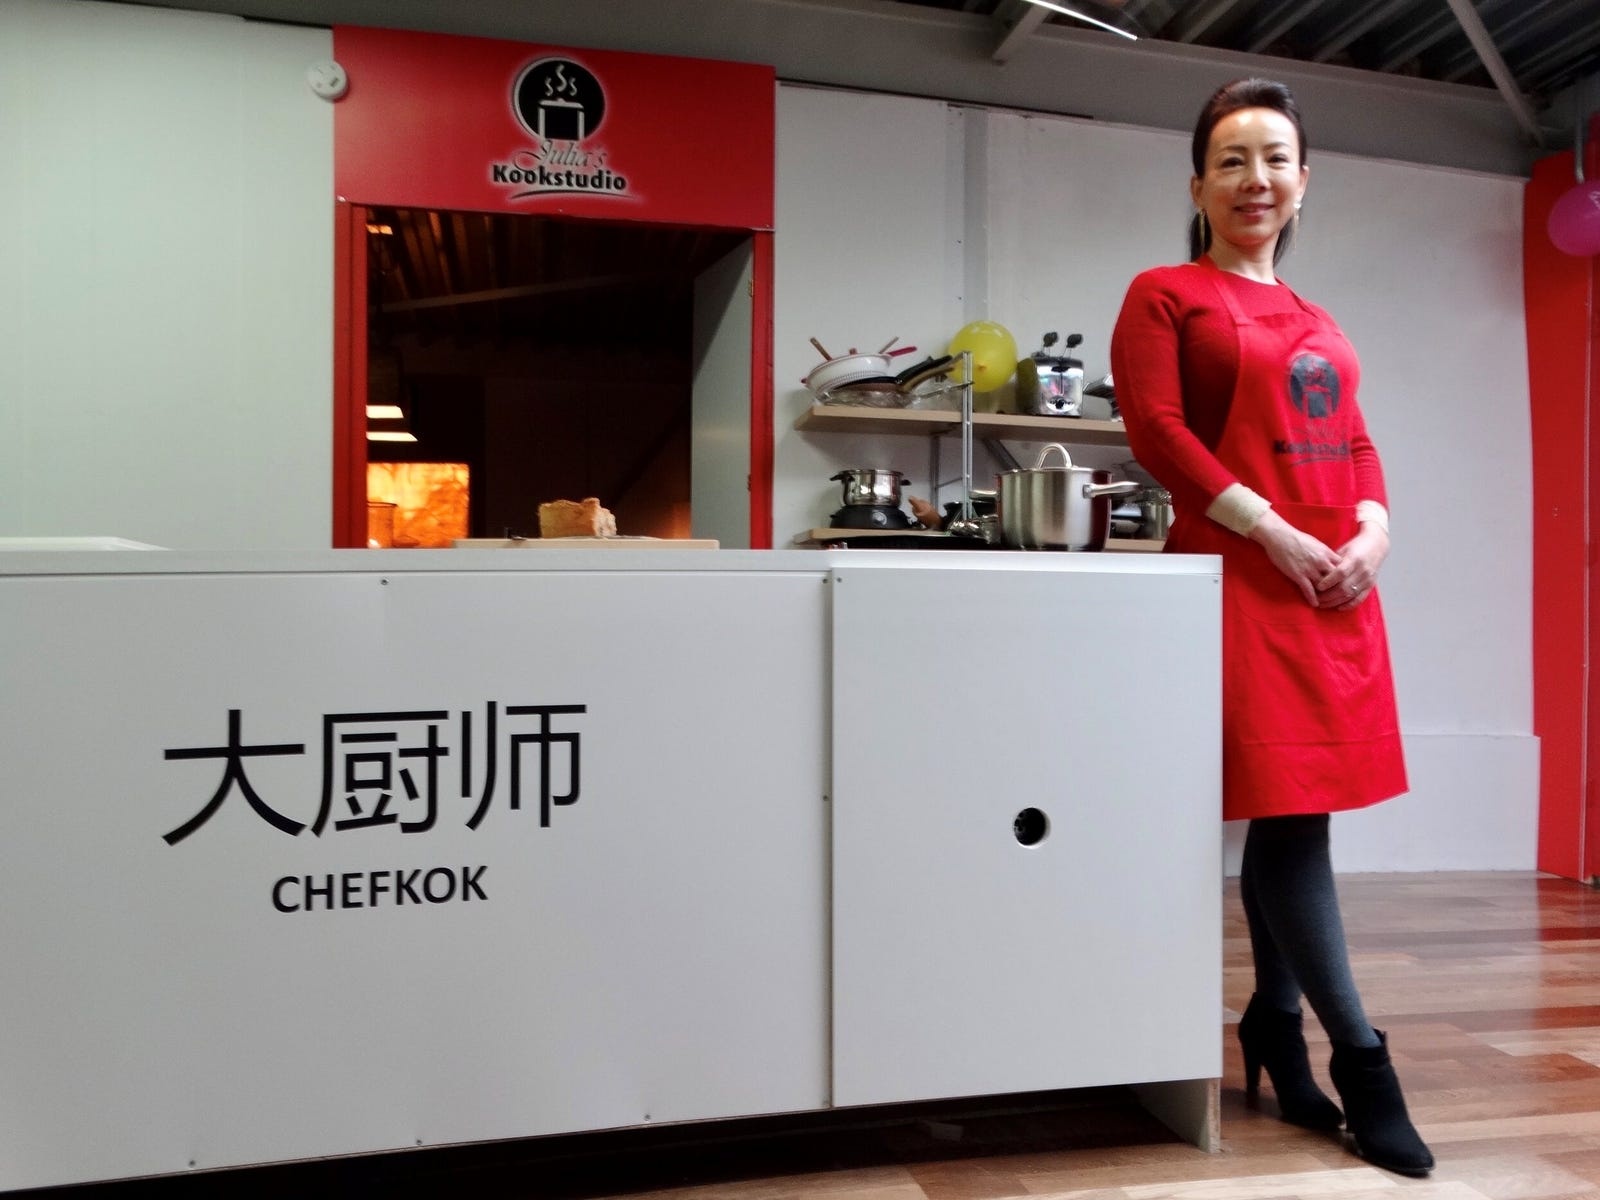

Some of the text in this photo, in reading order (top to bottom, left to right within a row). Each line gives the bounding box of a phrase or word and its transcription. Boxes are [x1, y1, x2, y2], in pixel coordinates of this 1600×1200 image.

[492, 164, 626, 190] Kookstudio
[162, 700, 588, 846] 大厨师
[271, 865, 489, 913] CHEFKOK
